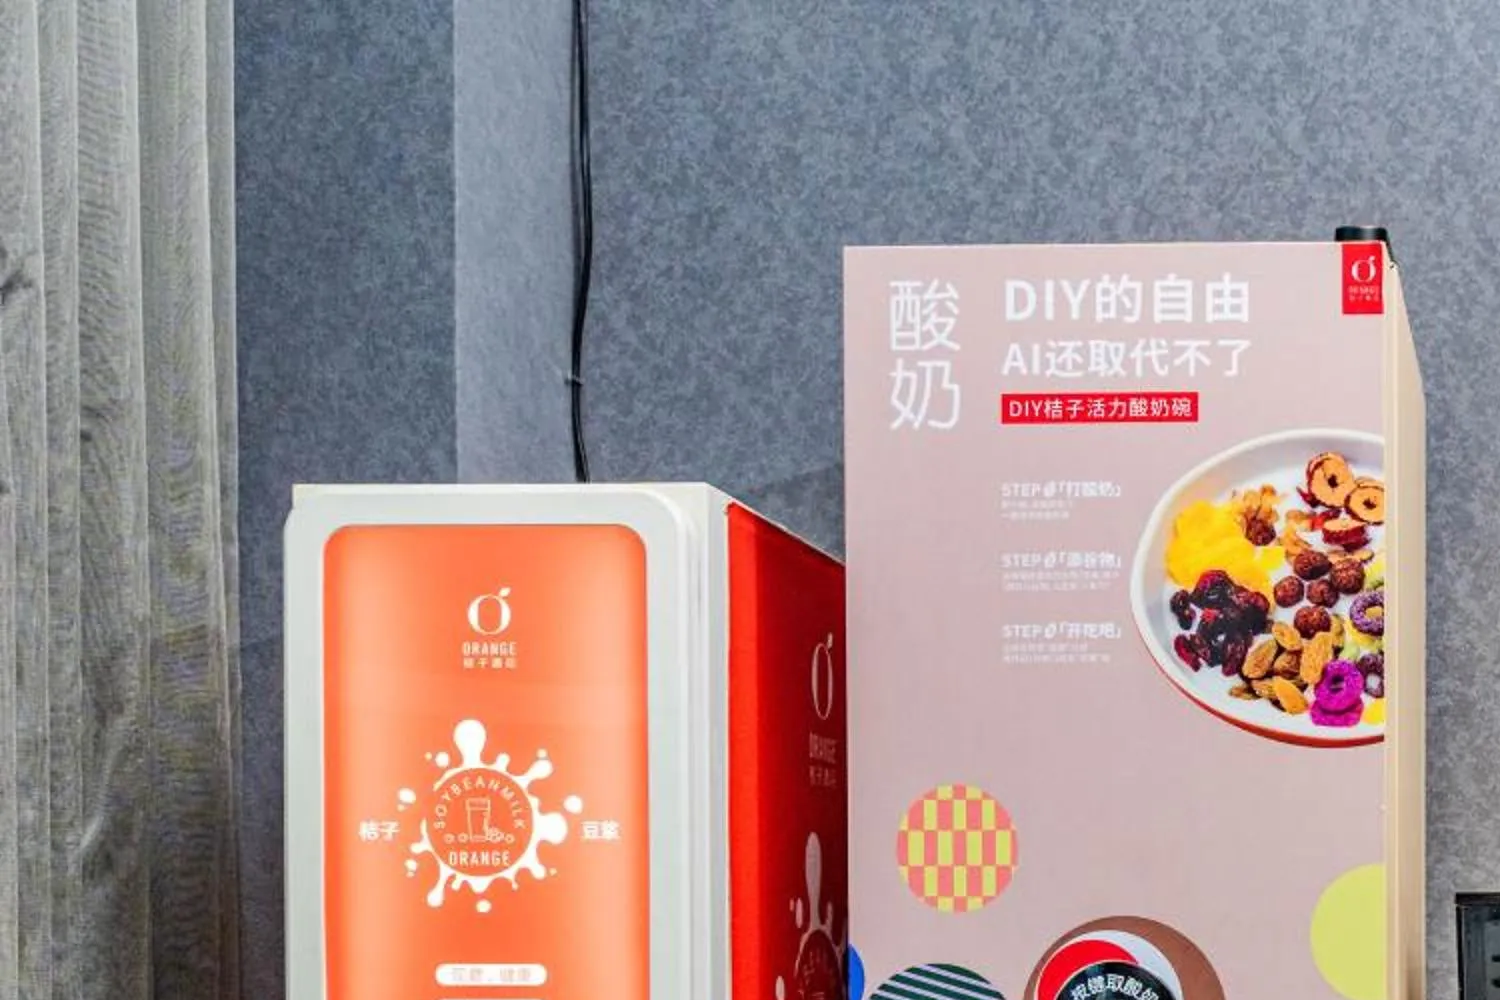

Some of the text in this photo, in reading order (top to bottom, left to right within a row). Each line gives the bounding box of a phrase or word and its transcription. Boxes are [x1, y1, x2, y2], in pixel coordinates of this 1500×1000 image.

[1004, 273, 1250, 323] DIY的自由
[889, 278, 961, 430] 酸奶
[1001, 339, 1252, 377] AI还取代不了
[1008, 397, 1193, 418] DIY桔子活力酸奶碗
[1001, 482, 1041, 497] STEP
[1001, 553, 1041, 568] STEP
[1002, 624, 1042, 639] STEP
[462, 641, 517, 656] ORANGE
[359, 821, 400, 842] 桔子
[448, 850, 511, 868] ORANGE
